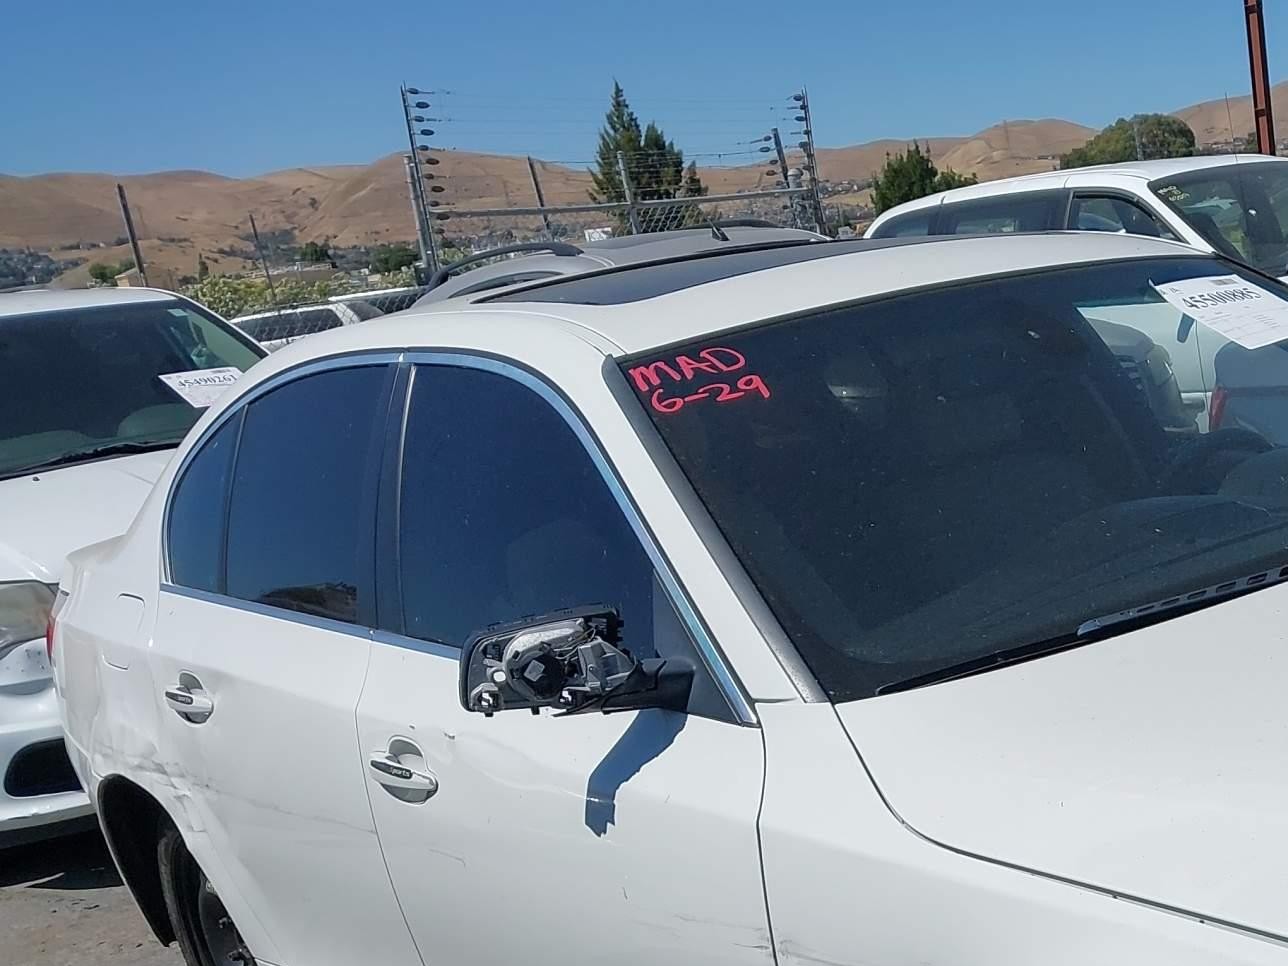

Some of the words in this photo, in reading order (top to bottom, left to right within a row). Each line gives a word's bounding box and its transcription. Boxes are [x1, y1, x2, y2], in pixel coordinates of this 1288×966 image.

[1181, 287, 1262, 310] 45500885
[628, 347, 746, 392] MAD
[651, 374, 770, 413] 6-29
